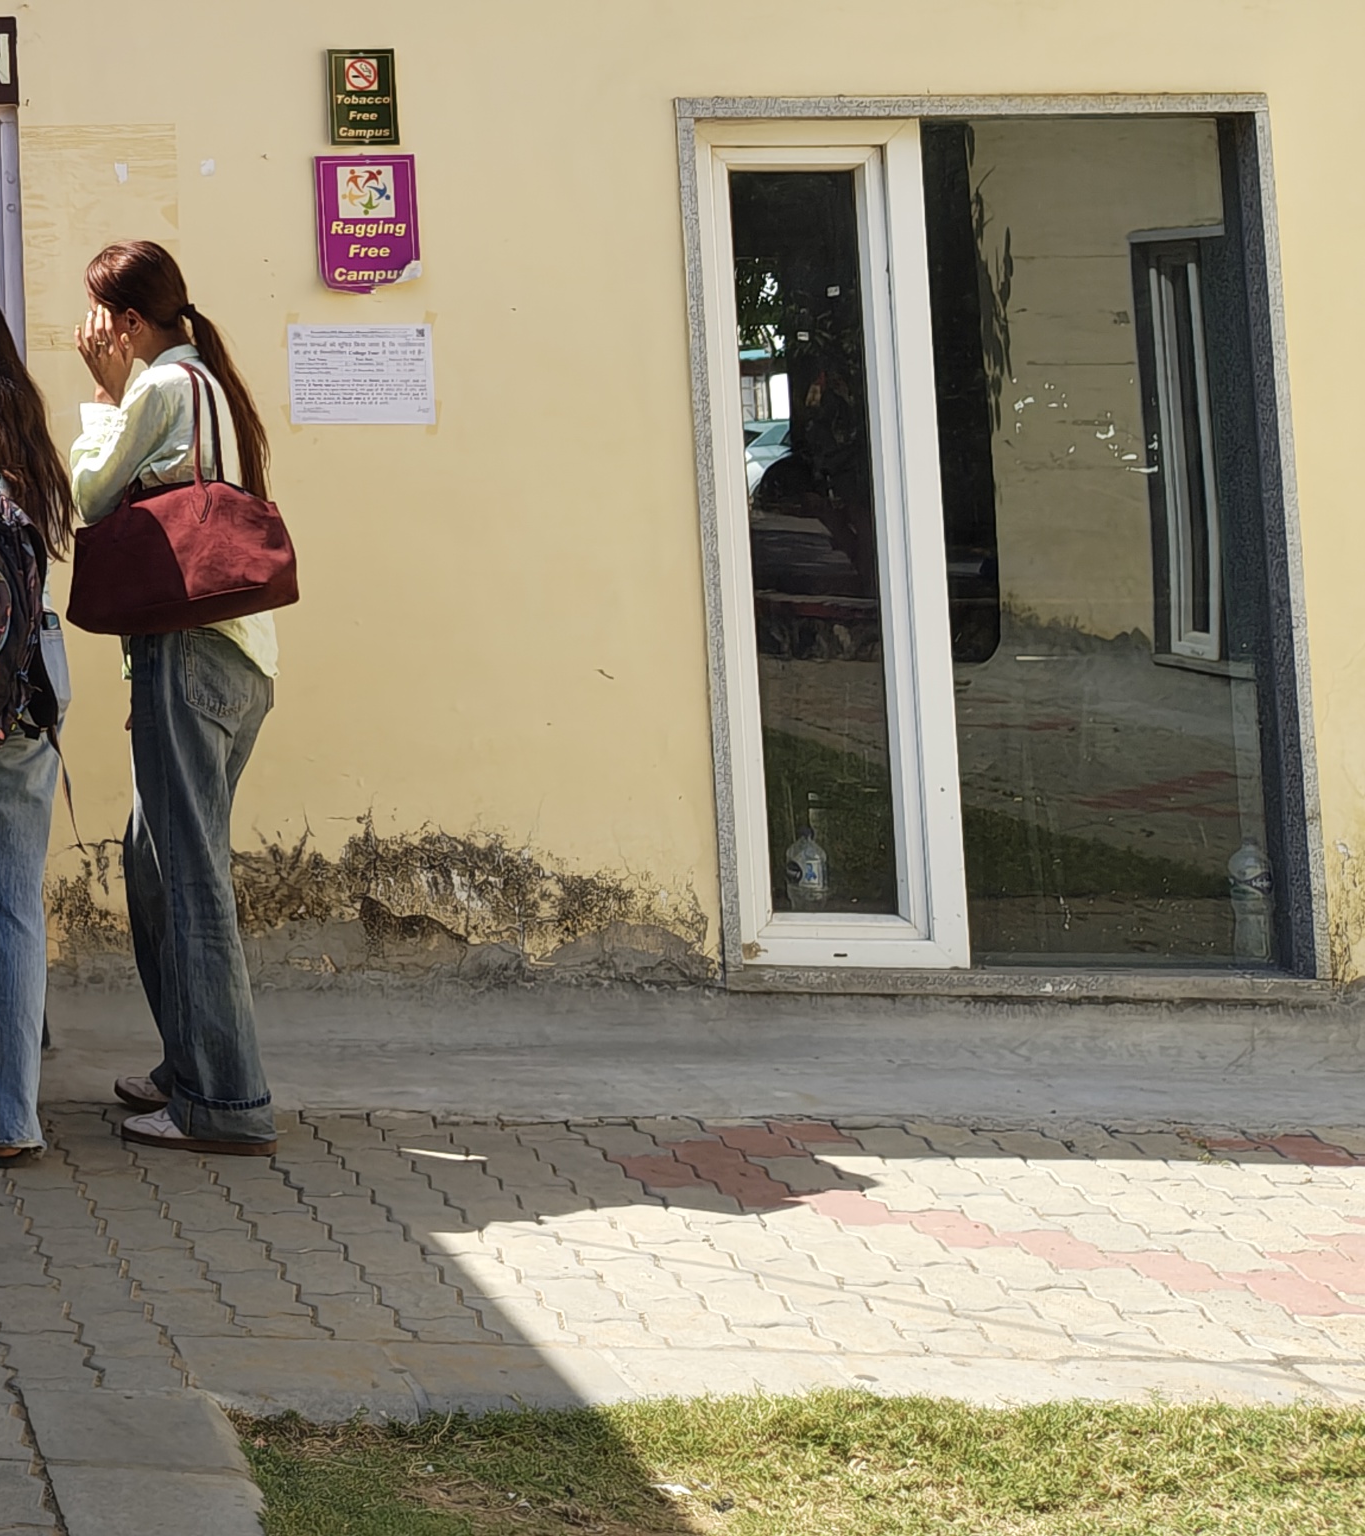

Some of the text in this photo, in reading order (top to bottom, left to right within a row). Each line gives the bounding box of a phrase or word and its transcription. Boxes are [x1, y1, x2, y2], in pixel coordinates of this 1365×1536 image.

[336, 94, 391, 105] Tobacco
[349, 110, 378, 121] Free
[339, 126, 390, 139] Campus
[330, 220, 407, 238] Ragging
[348, 244, 391, 258] Free
[334, 267, 403, 283] Campu
